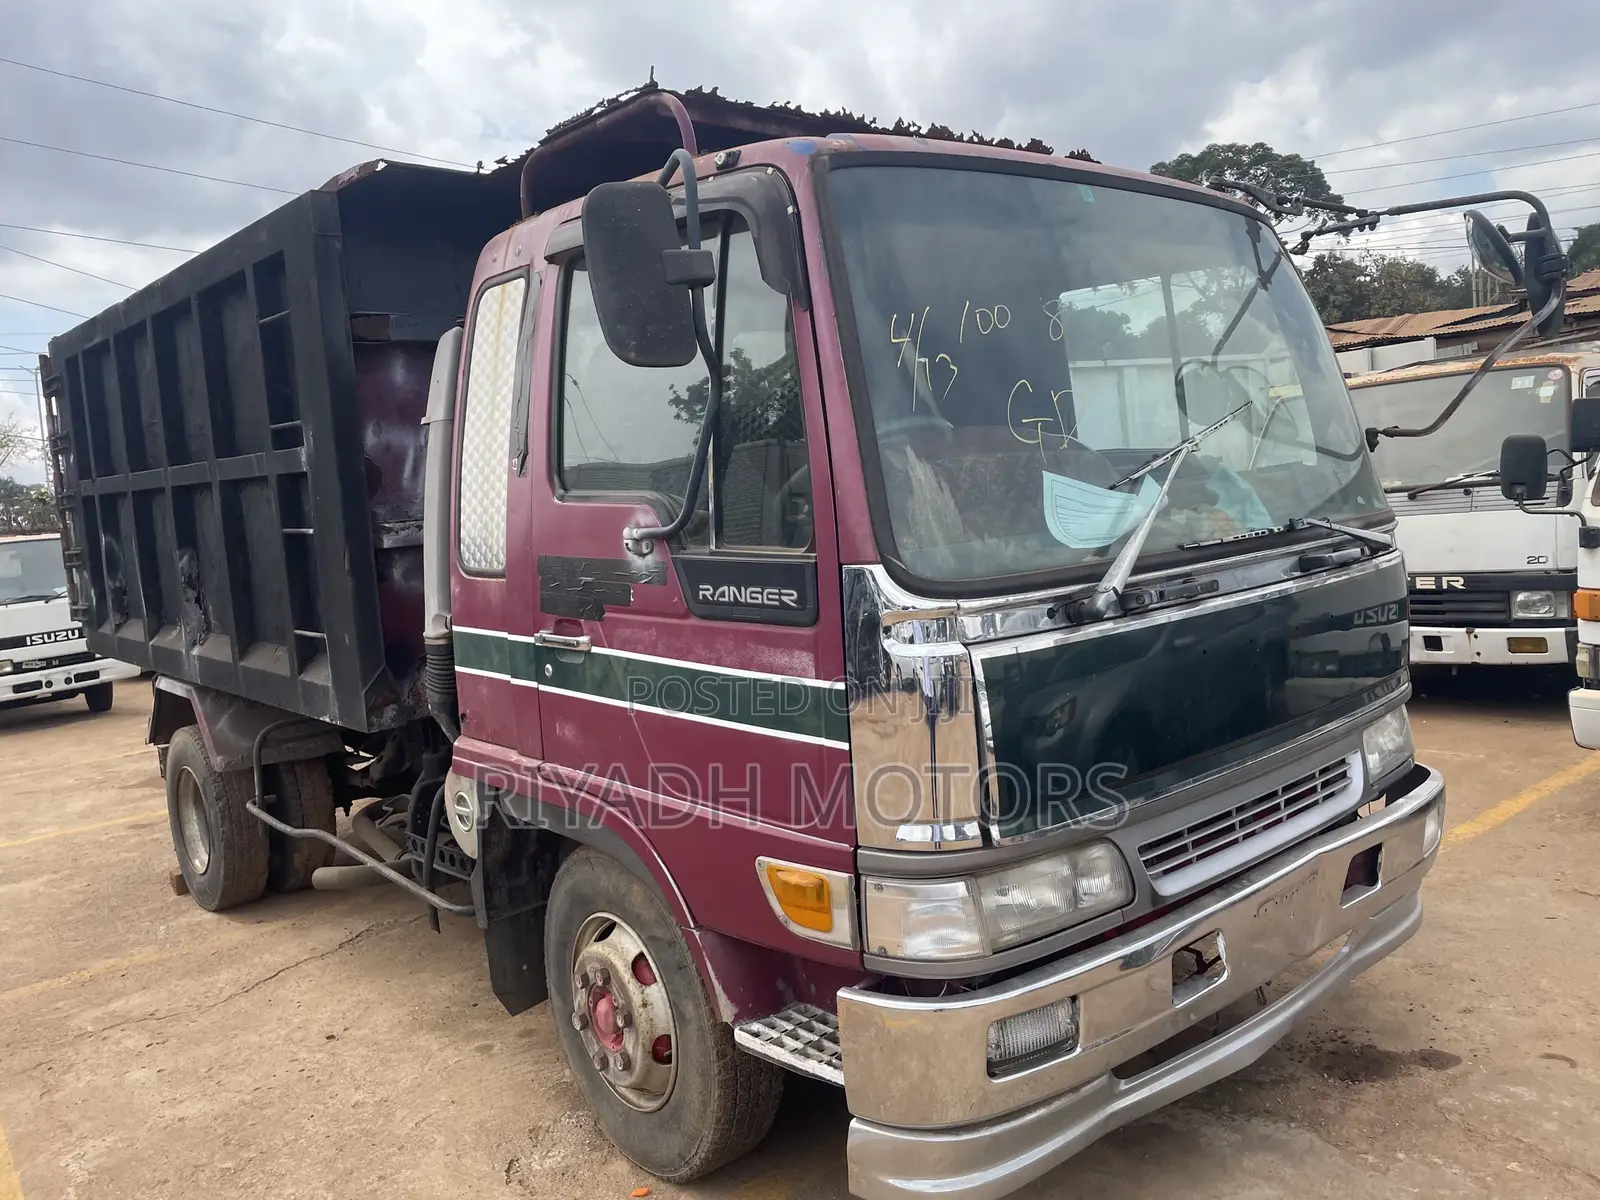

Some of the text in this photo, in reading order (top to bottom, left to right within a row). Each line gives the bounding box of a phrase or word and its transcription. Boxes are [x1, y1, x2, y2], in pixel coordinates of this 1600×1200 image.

[1526, 555, 1549, 564] 20
[1408, 576, 1466, 589] ER
[698, 584, 798, 607] RANGER
[26, 629, 79, 645] ISUZU
